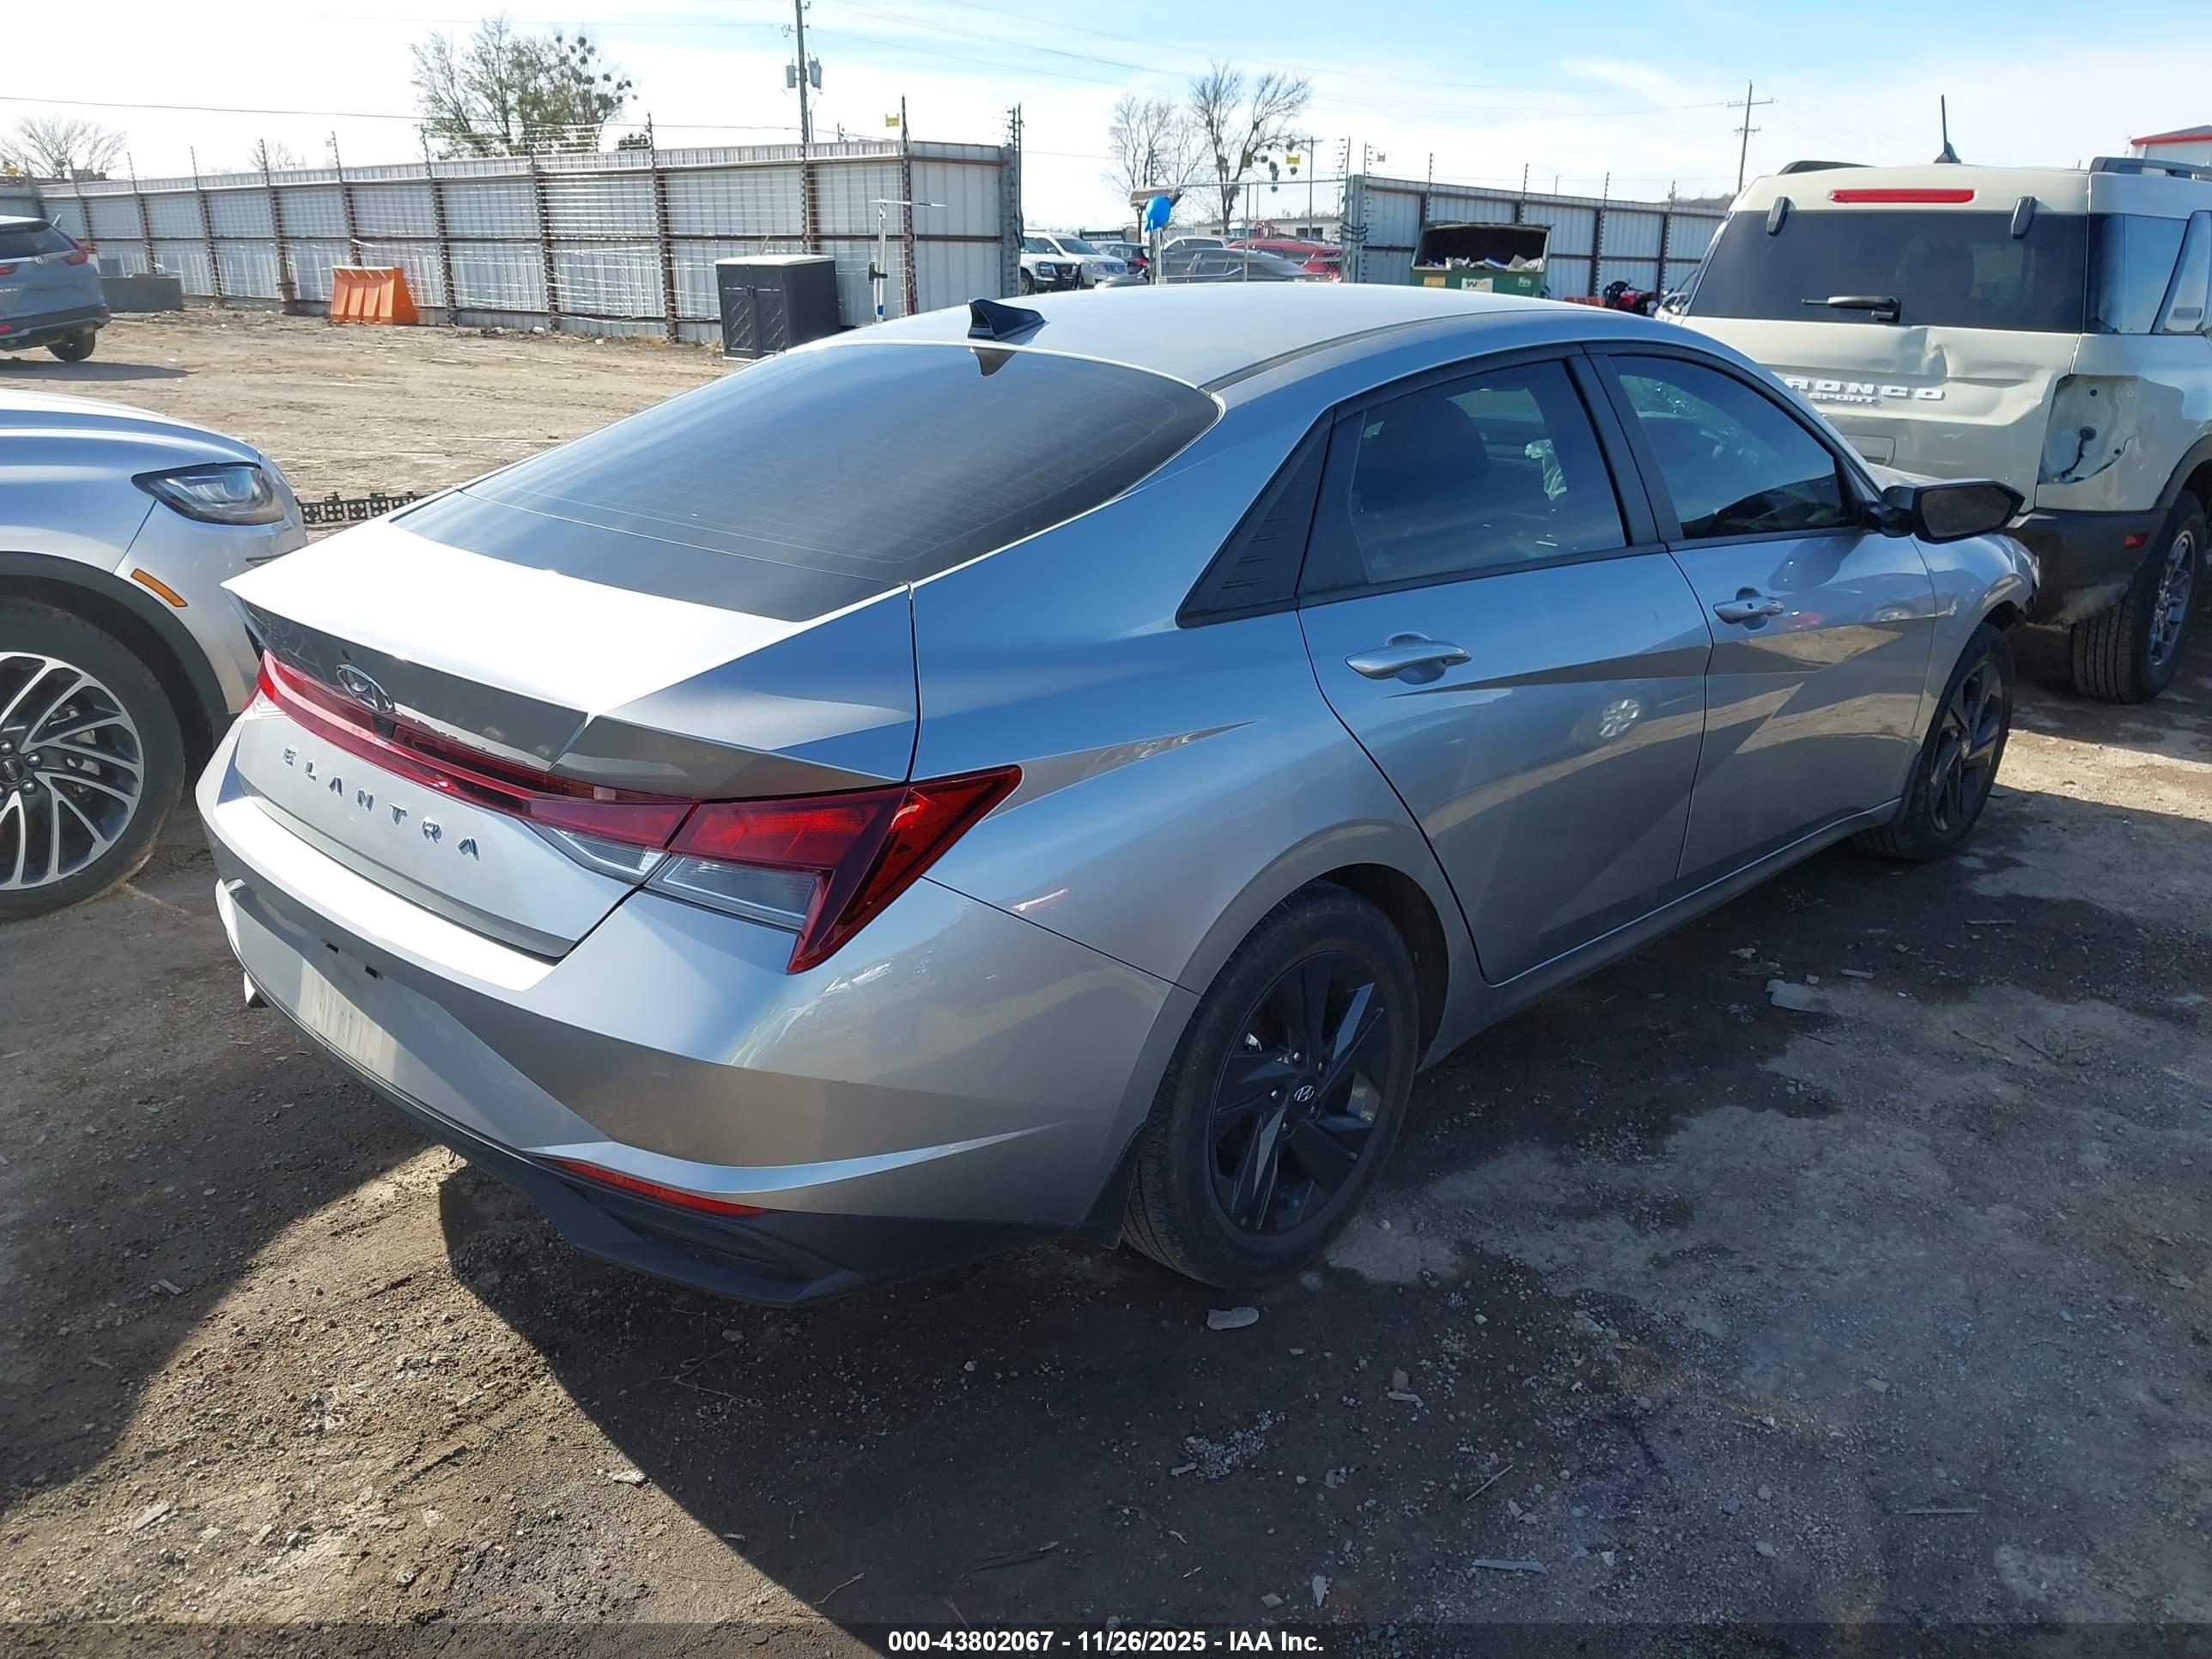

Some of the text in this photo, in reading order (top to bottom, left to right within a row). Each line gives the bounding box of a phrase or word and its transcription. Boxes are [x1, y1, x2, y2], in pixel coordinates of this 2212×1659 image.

[1784, 378, 1945, 400] RONCO
[1808, 392, 1878, 403] SPORT
[283, 746, 480, 861] ELANTRA
